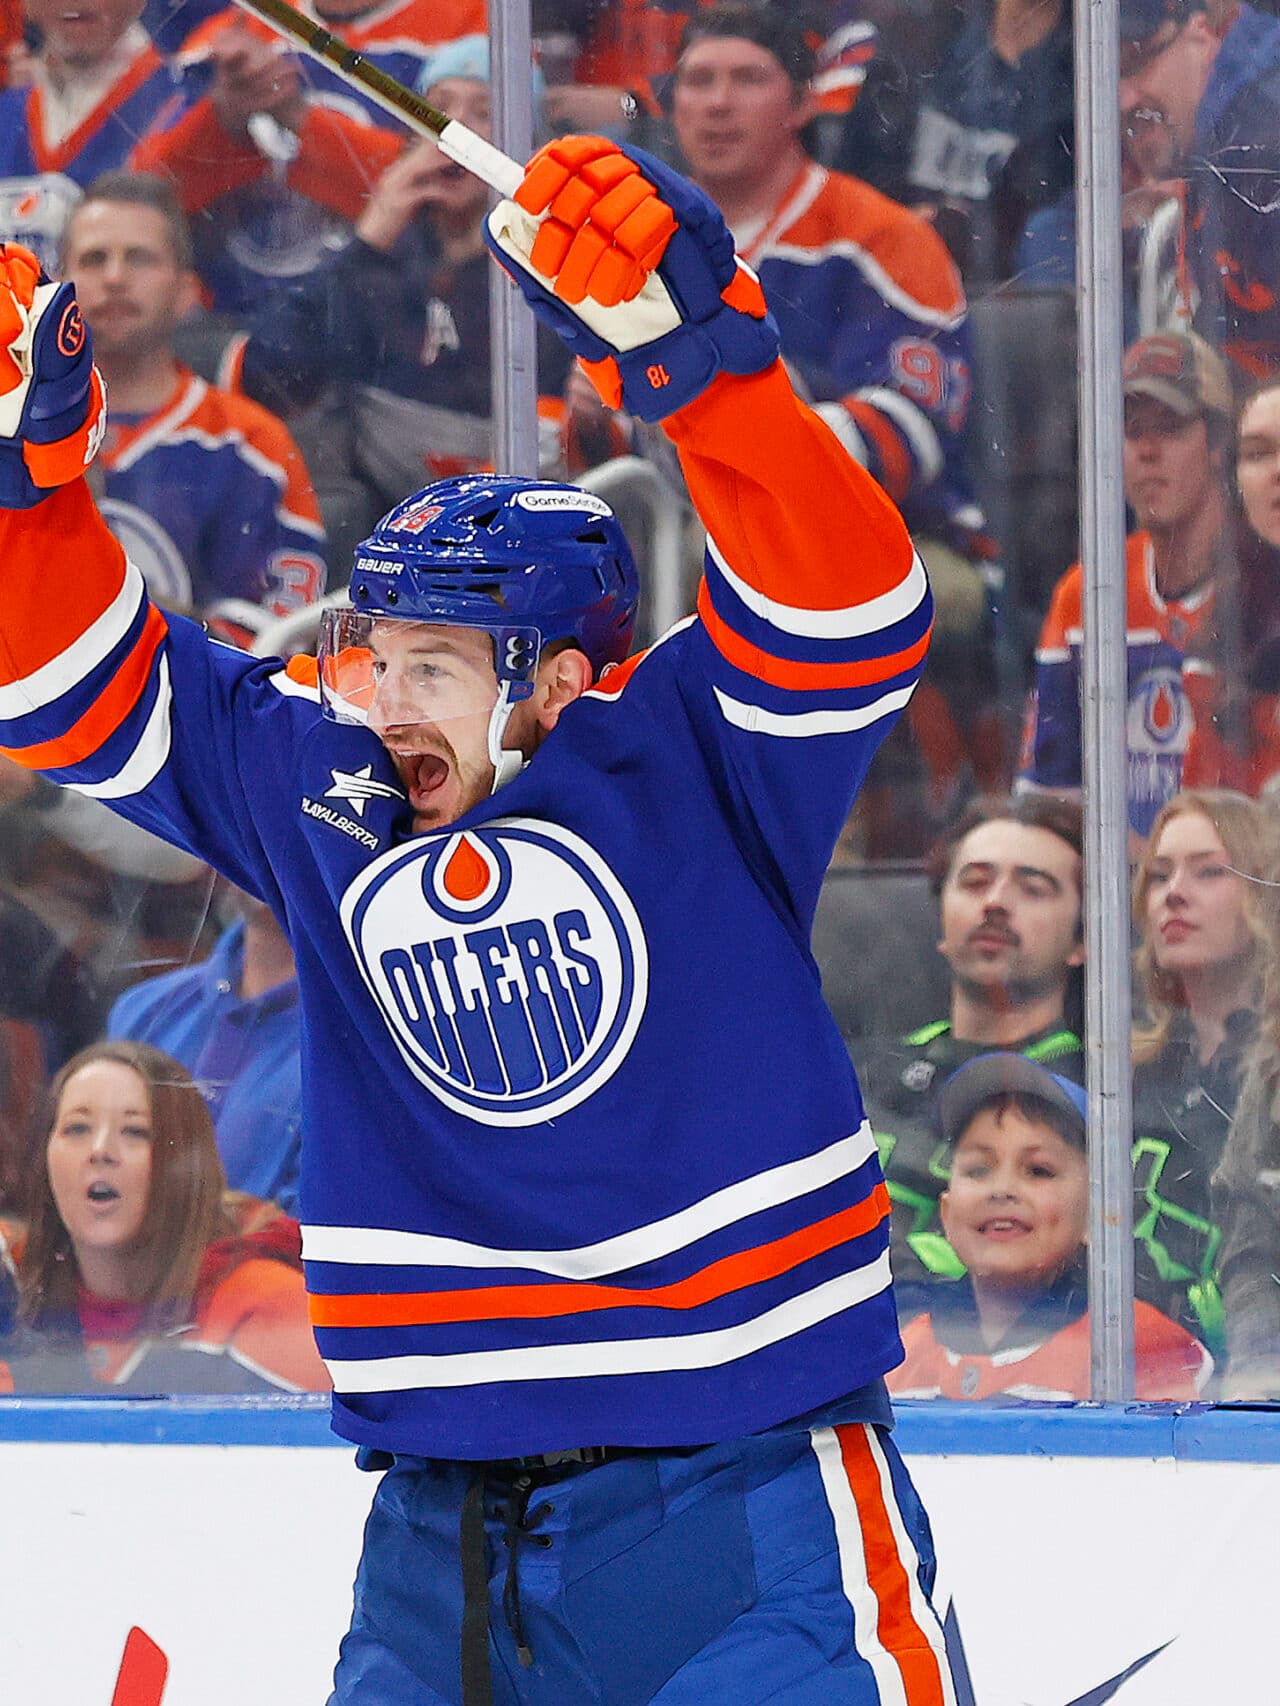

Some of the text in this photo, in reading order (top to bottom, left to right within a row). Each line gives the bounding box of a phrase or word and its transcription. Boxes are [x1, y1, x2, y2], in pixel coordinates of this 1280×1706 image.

[646, 364, 671, 389] 18
[356, 557, 405, 576] BAUER
[379, 908, 604, 1097] OILERS
